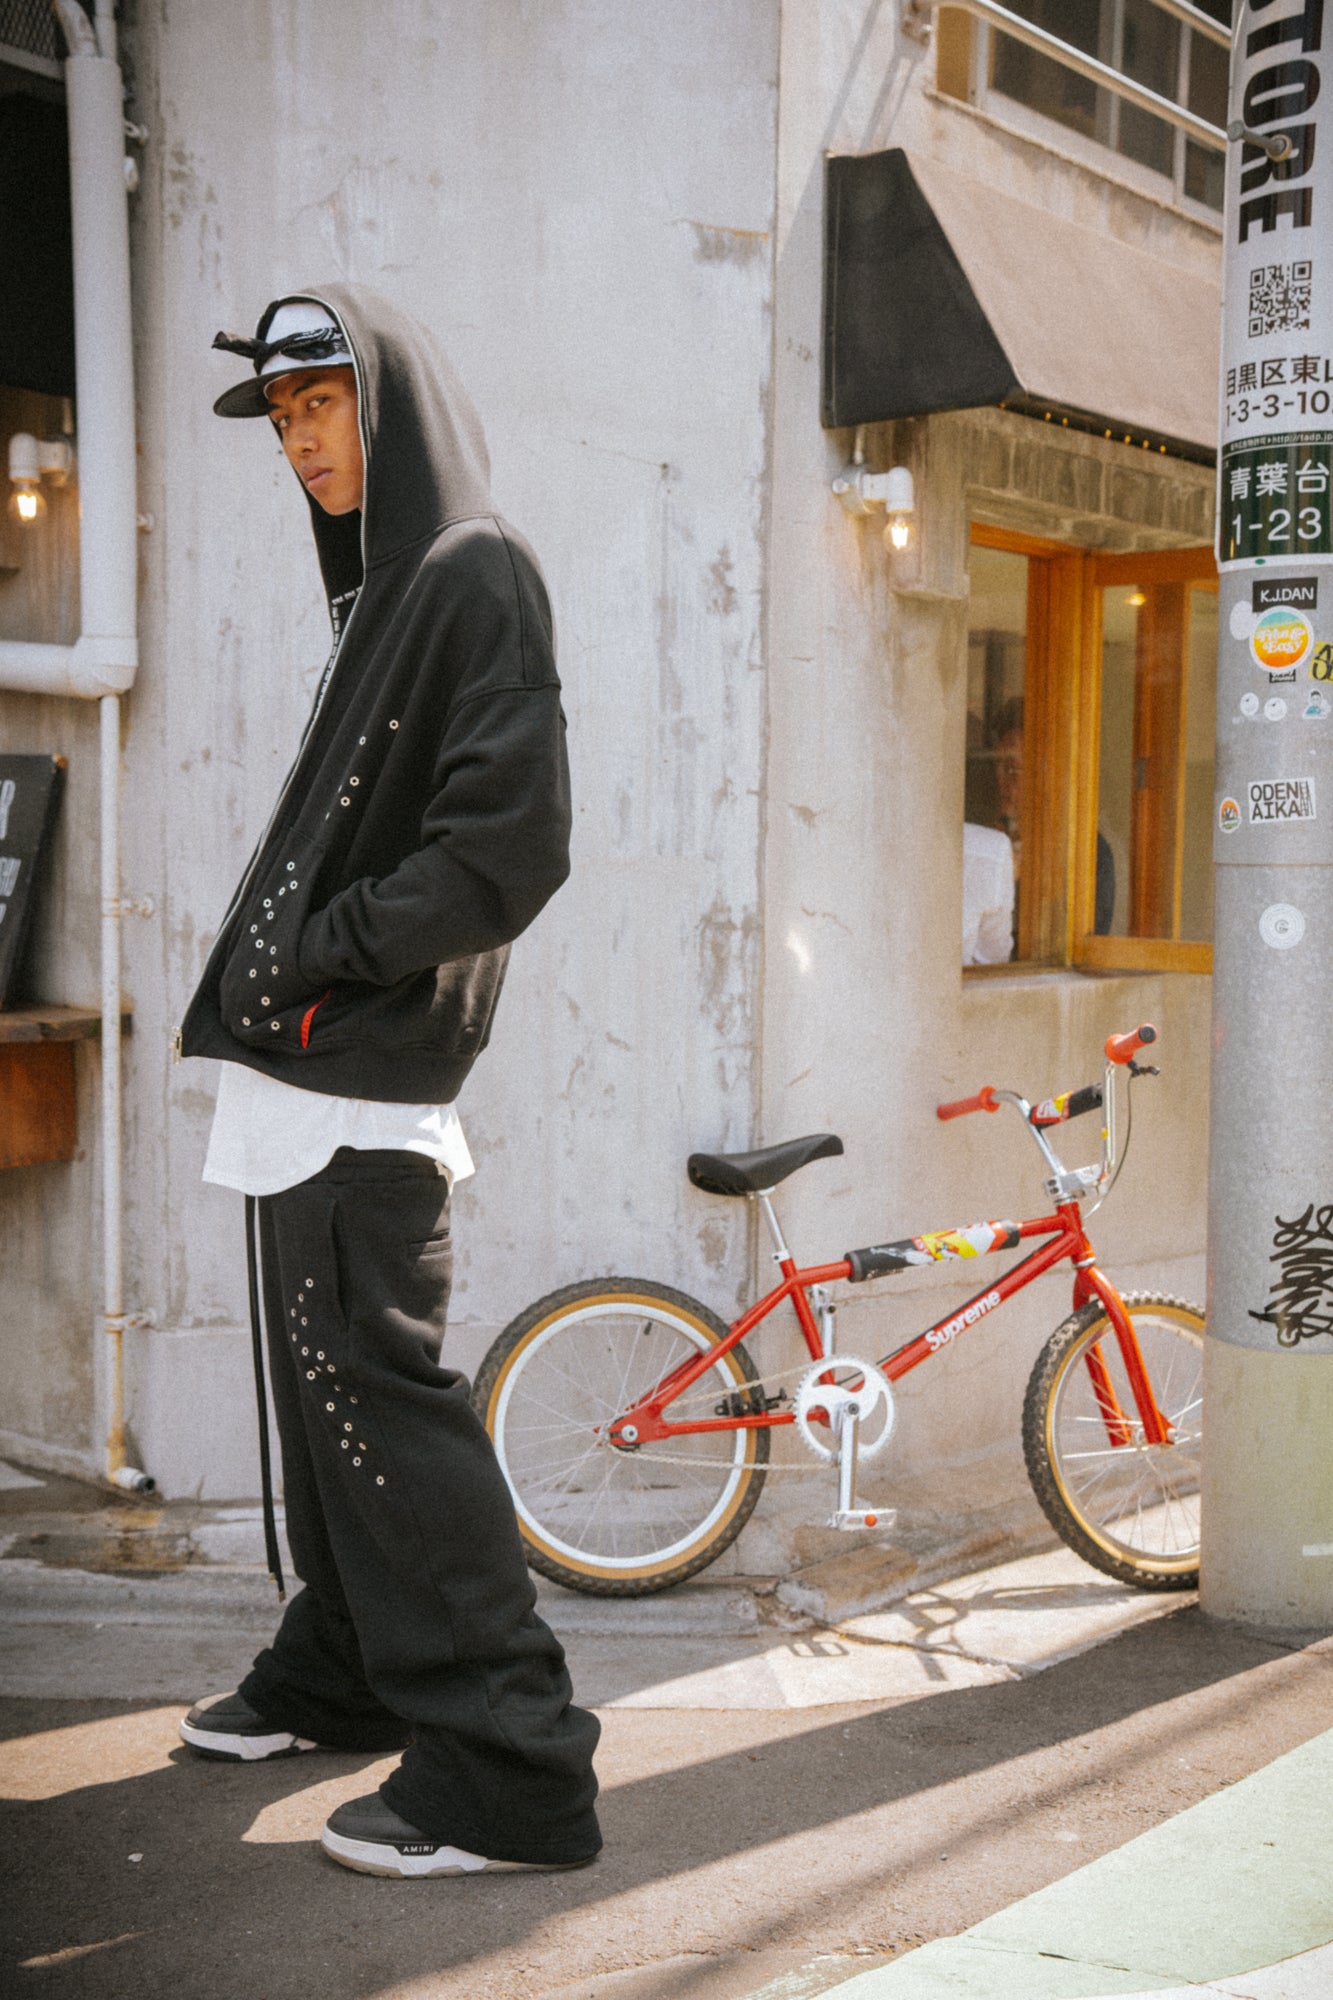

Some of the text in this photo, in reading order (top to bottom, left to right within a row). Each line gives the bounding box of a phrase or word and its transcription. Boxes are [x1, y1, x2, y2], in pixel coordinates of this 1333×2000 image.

[1238, 0, 1323, 244] TORE
[1229, 459, 1330, 502] 青葉台
[1232, 506, 1322, 546] 1-23
[1250, 781, 1299, 803] ODEN
[925, 1291, 1001, 1351] Supreme
[402, 1845, 434, 1853] AMIRI
